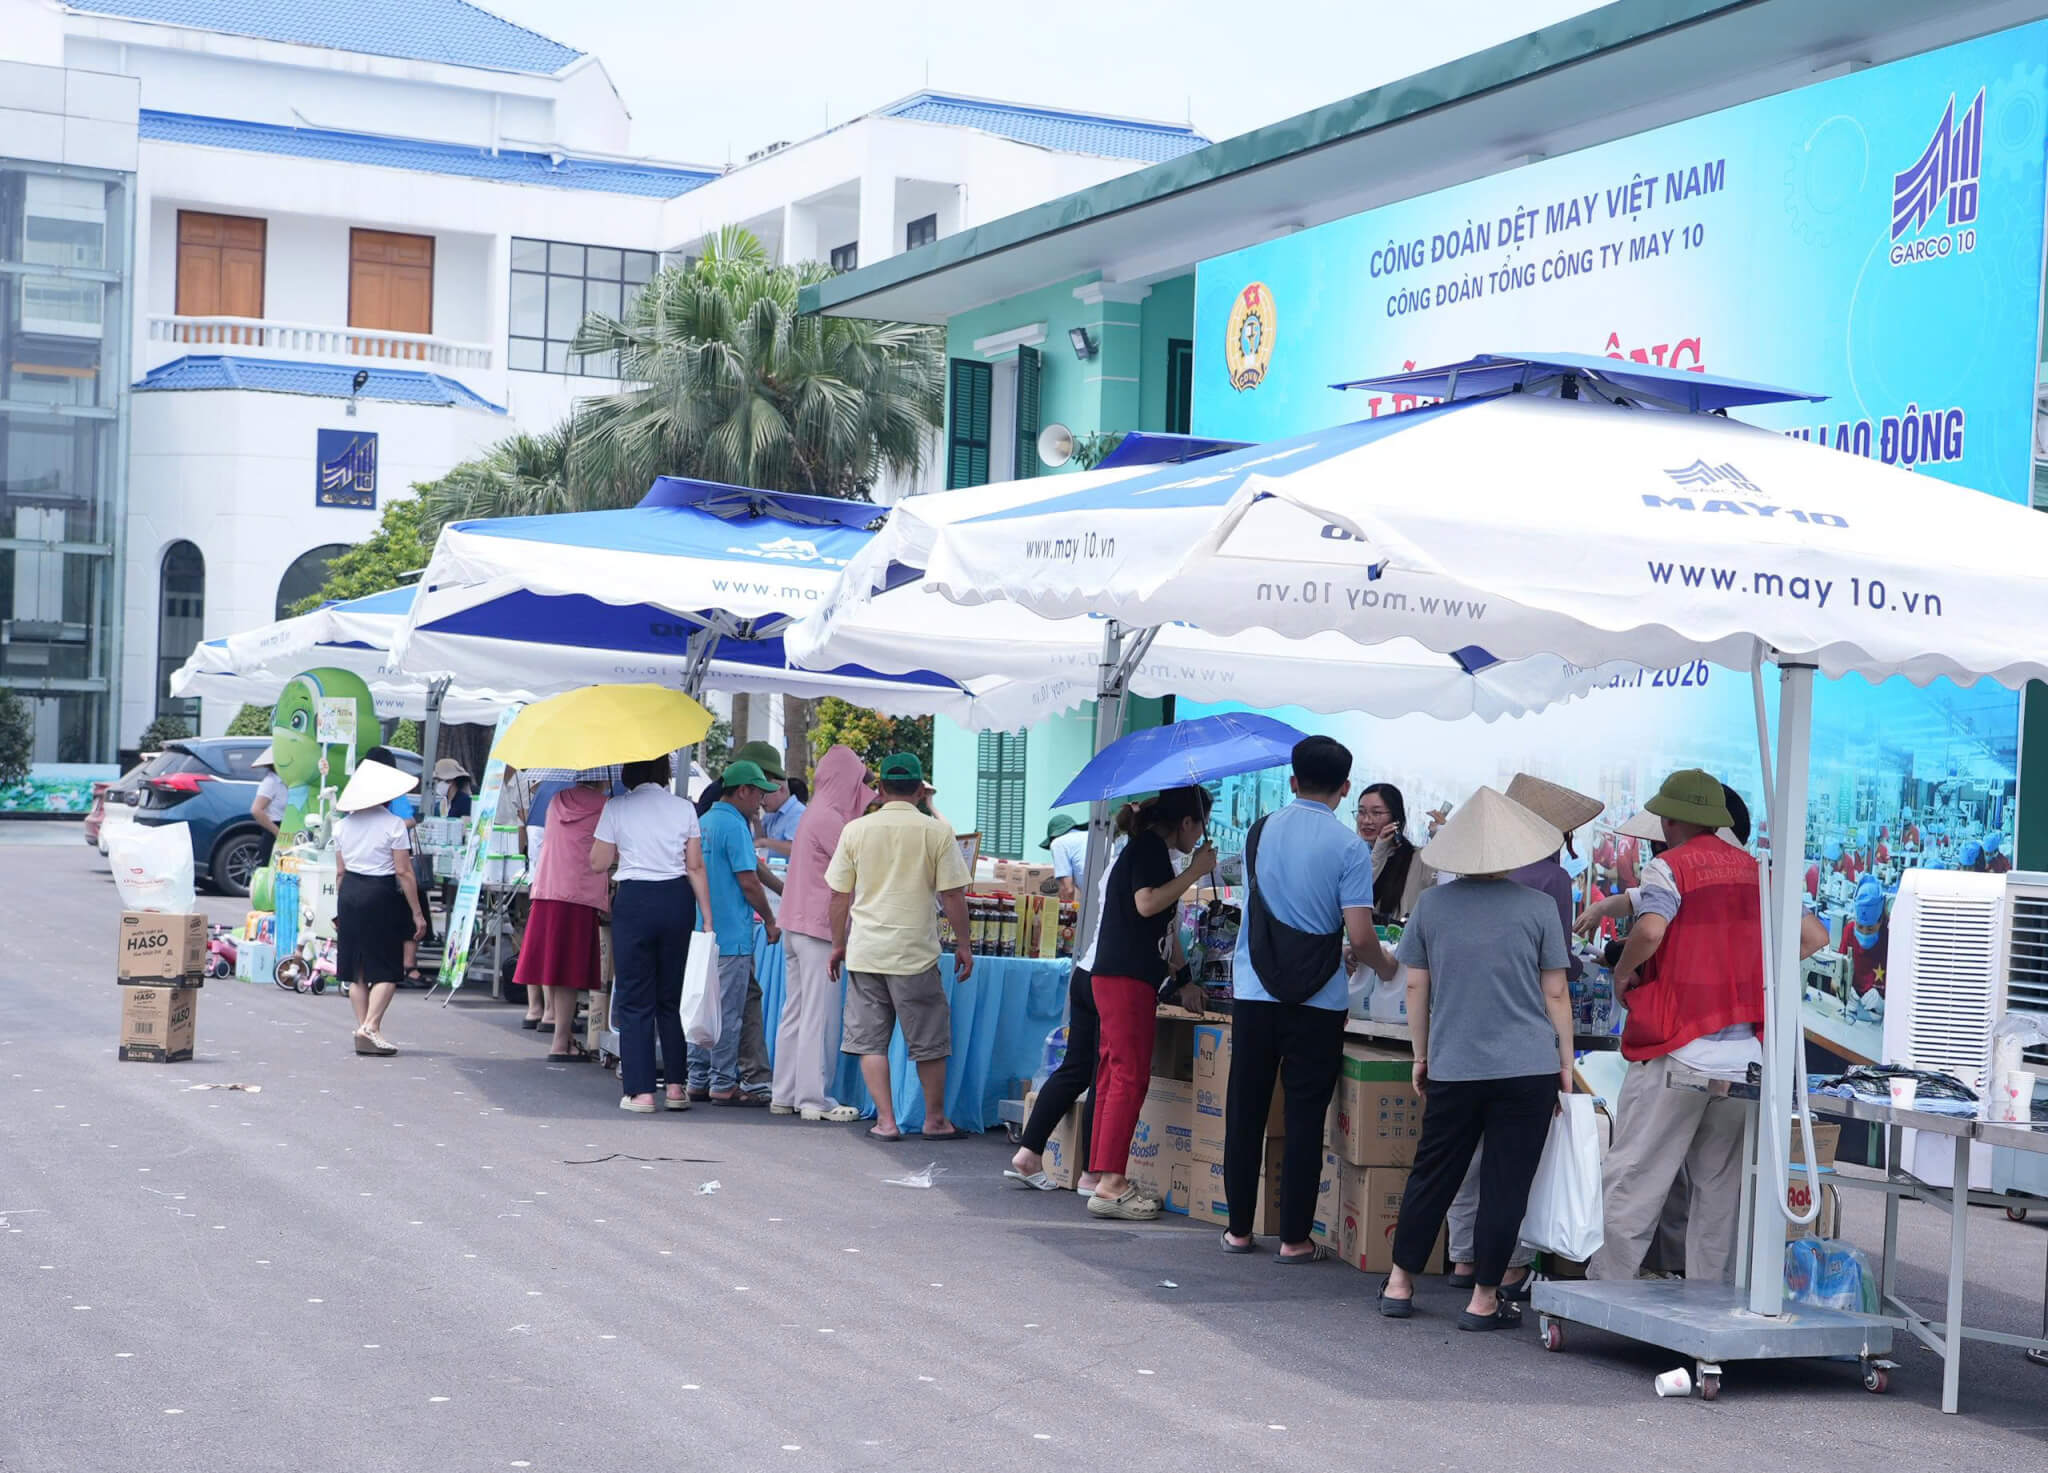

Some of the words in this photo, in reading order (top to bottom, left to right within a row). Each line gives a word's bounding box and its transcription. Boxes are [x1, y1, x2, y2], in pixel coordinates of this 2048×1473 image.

[1370, 240, 1424, 278] CÔNG
[1431, 220, 1491, 262] ĐOÀN
[1497, 206, 1539, 250] DỆT
[1545, 193, 1598, 234] MAY
[1606, 173, 1658, 222] VIỆT
[1665, 159, 1725, 204] NAM
[1891, 236, 1951, 265] GARCO
[1957, 231, 1975, 251] 10
[1386, 288, 1430, 317] CÔNG
[1436, 273, 1483, 306] ĐOÀN
[1489, 255, 1535, 294] TỔNG
[1542, 250, 1593, 283] CÔNG
[1599, 241, 1623, 268] TY
[1629, 229, 1674, 263] MAY
[1682, 224, 1704, 249] 10
[1641, 494, 1849, 528] MAY10
[1025, 538, 1080, 565] www.may
[1083, 531, 1115, 559] 10.vn
[712, 578, 825, 600] www.ma
[1647, 560, 1833, 608] www.may
[1850, 577, 1942, 616] 10.vn
[127, 934, 169, 951] HASO
[134, 992, 156, 1001] HASO
[171, 1007, 190, 1027] HASO
